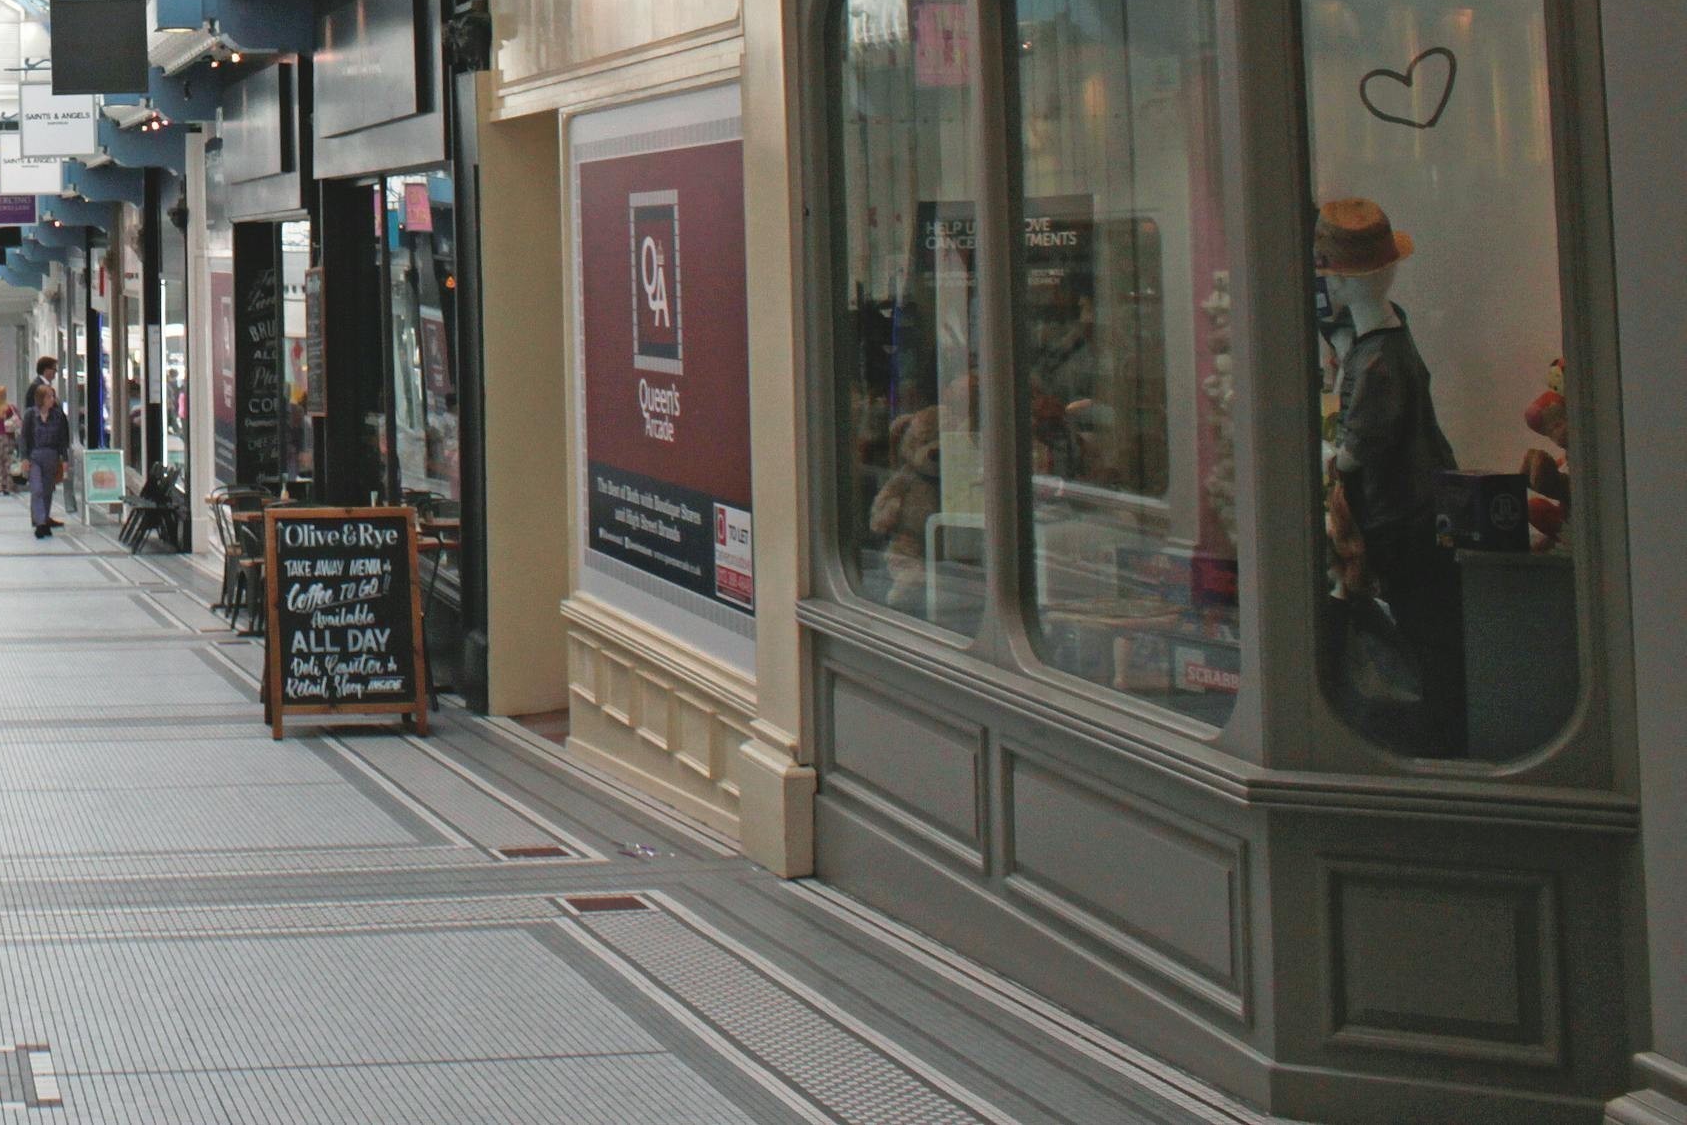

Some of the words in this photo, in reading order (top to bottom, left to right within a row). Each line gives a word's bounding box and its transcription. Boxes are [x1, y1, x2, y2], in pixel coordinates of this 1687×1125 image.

[25, 112, 52, 121] SAINTS
[54, 112, 60, 120] &
[61, 111, 91, 120] ANGELS
[925, 235, 976, 250] CANCE
[638, 378, 681, 418] Queen's
[644, 414, 675, 443] Arcade
[284, 523, 340, 547] Olive
[358, 522, 399, 549] Rye
[283, 559, 313, 577] TAKE
[313, 558, 345, 577] AWAY
[285, 582, 333, 613] Coffee
[339, 581, 357, 601] TO
[358, 576, 380, 598] GO
[310, 602, 376, 630] Available
[291, 628, 341, 654] ALL
[346, 627, 392, 653] DAY
[290, 655, 322, 677] Deli
[324, 653, 385, 676] Counter
[1187, 665, 1239, 686] SCRABB
[285, 675, 330, 700] Retail
[333, 673, 366, 700] Shop
